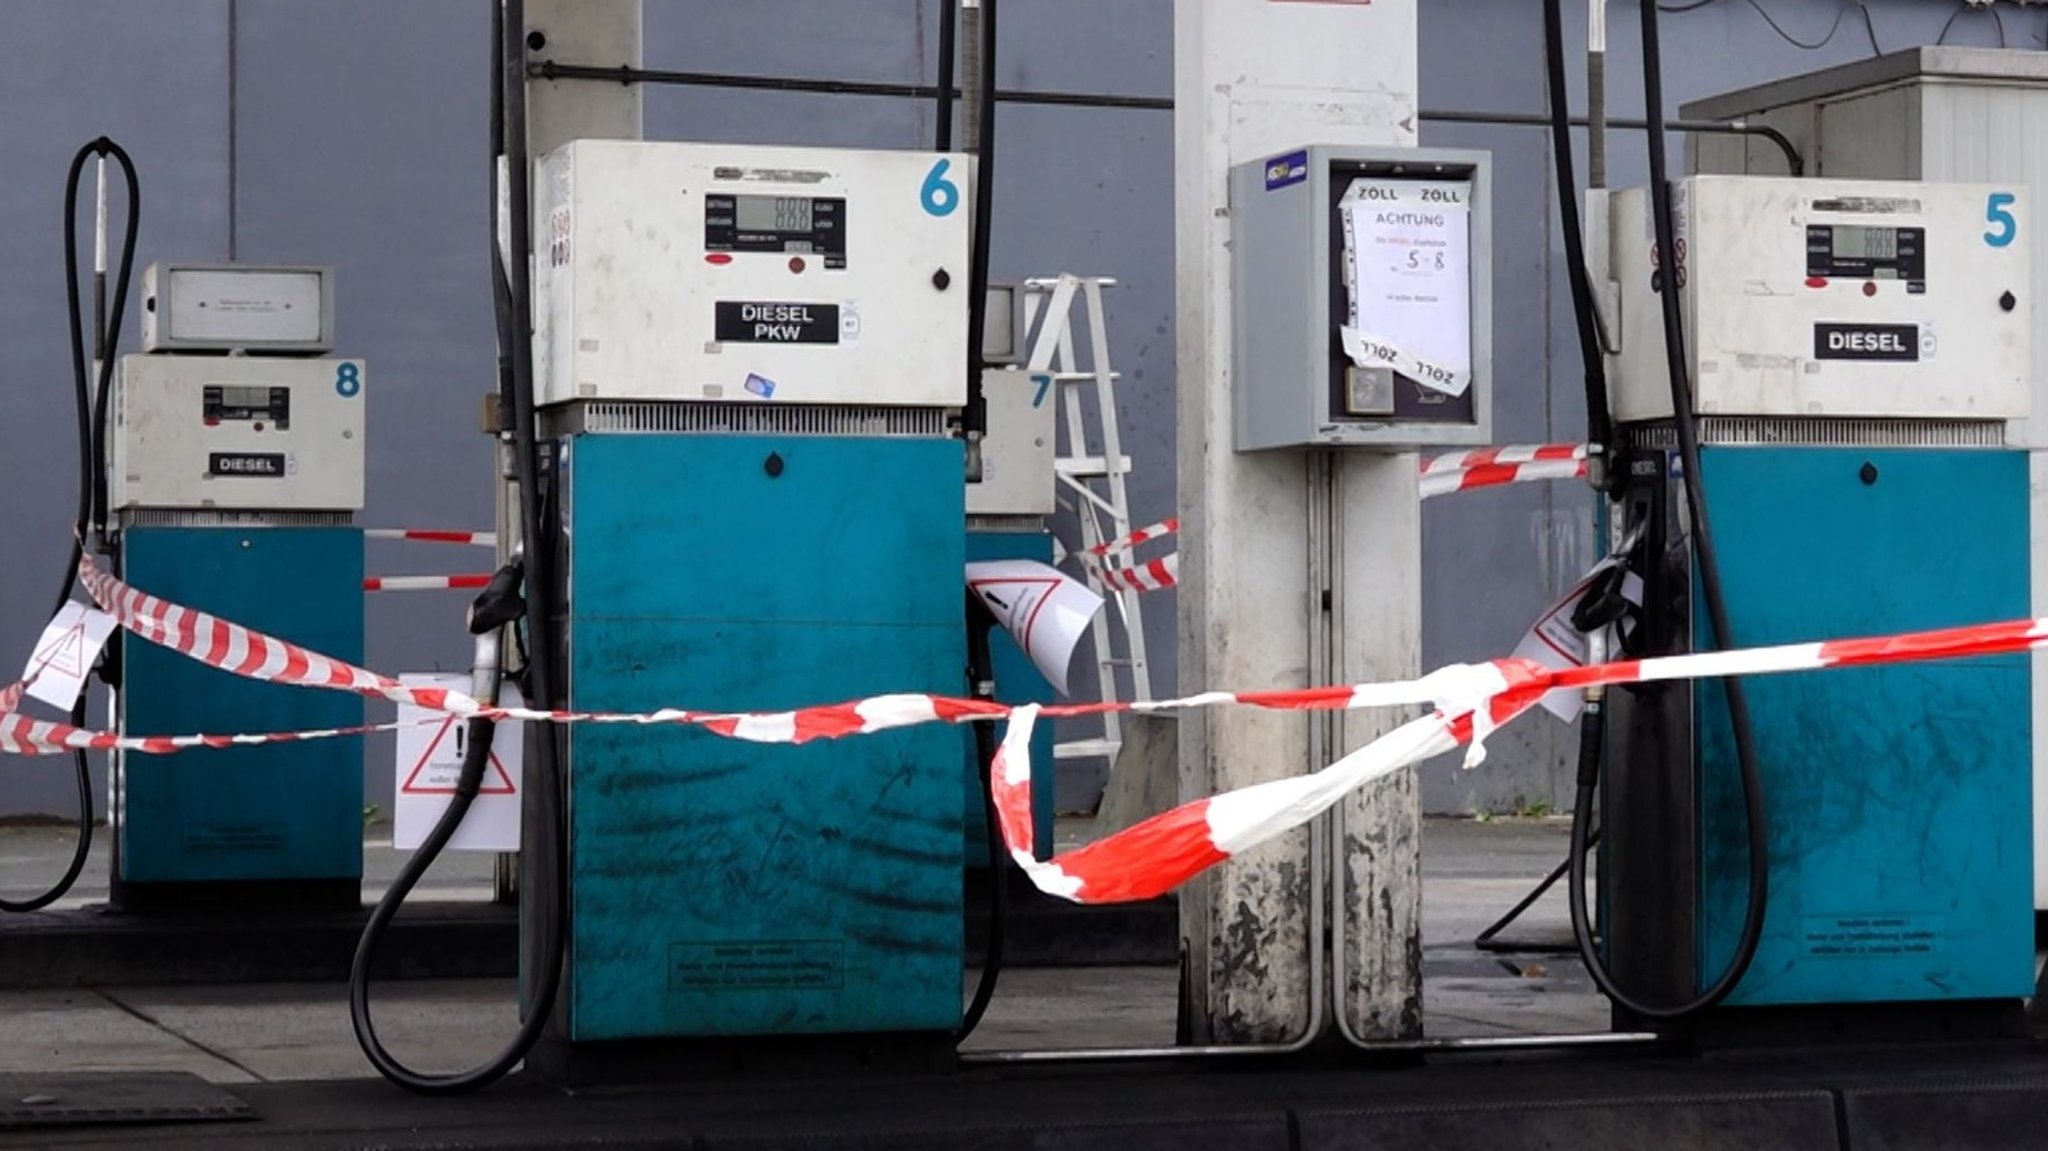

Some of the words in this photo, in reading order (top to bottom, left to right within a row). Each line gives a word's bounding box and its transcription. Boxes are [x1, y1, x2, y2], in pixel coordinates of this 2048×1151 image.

[920, 158, 959, 216] 6
[1358, 186, 1399, 201] ZOLL
[1421, 188, 1461, 203] ZOLL
[1375, 213, 1445, 228] ACHTUNG
[1983, 192, 2017, 248] 5
[741, 304, 814, 323] DIESEL
[754, 323, 801, 341] PKW
[1828, 331, 1907, 352] DIESEL
[1360, 340, 1398, 363] ZOLL
[1415, 361, 1455, 385] ZOLL
[335, 362, 360, 398] 8
[1030, 375, 1051, 409] 7
[220, 458, 276, 472] DIESEL
